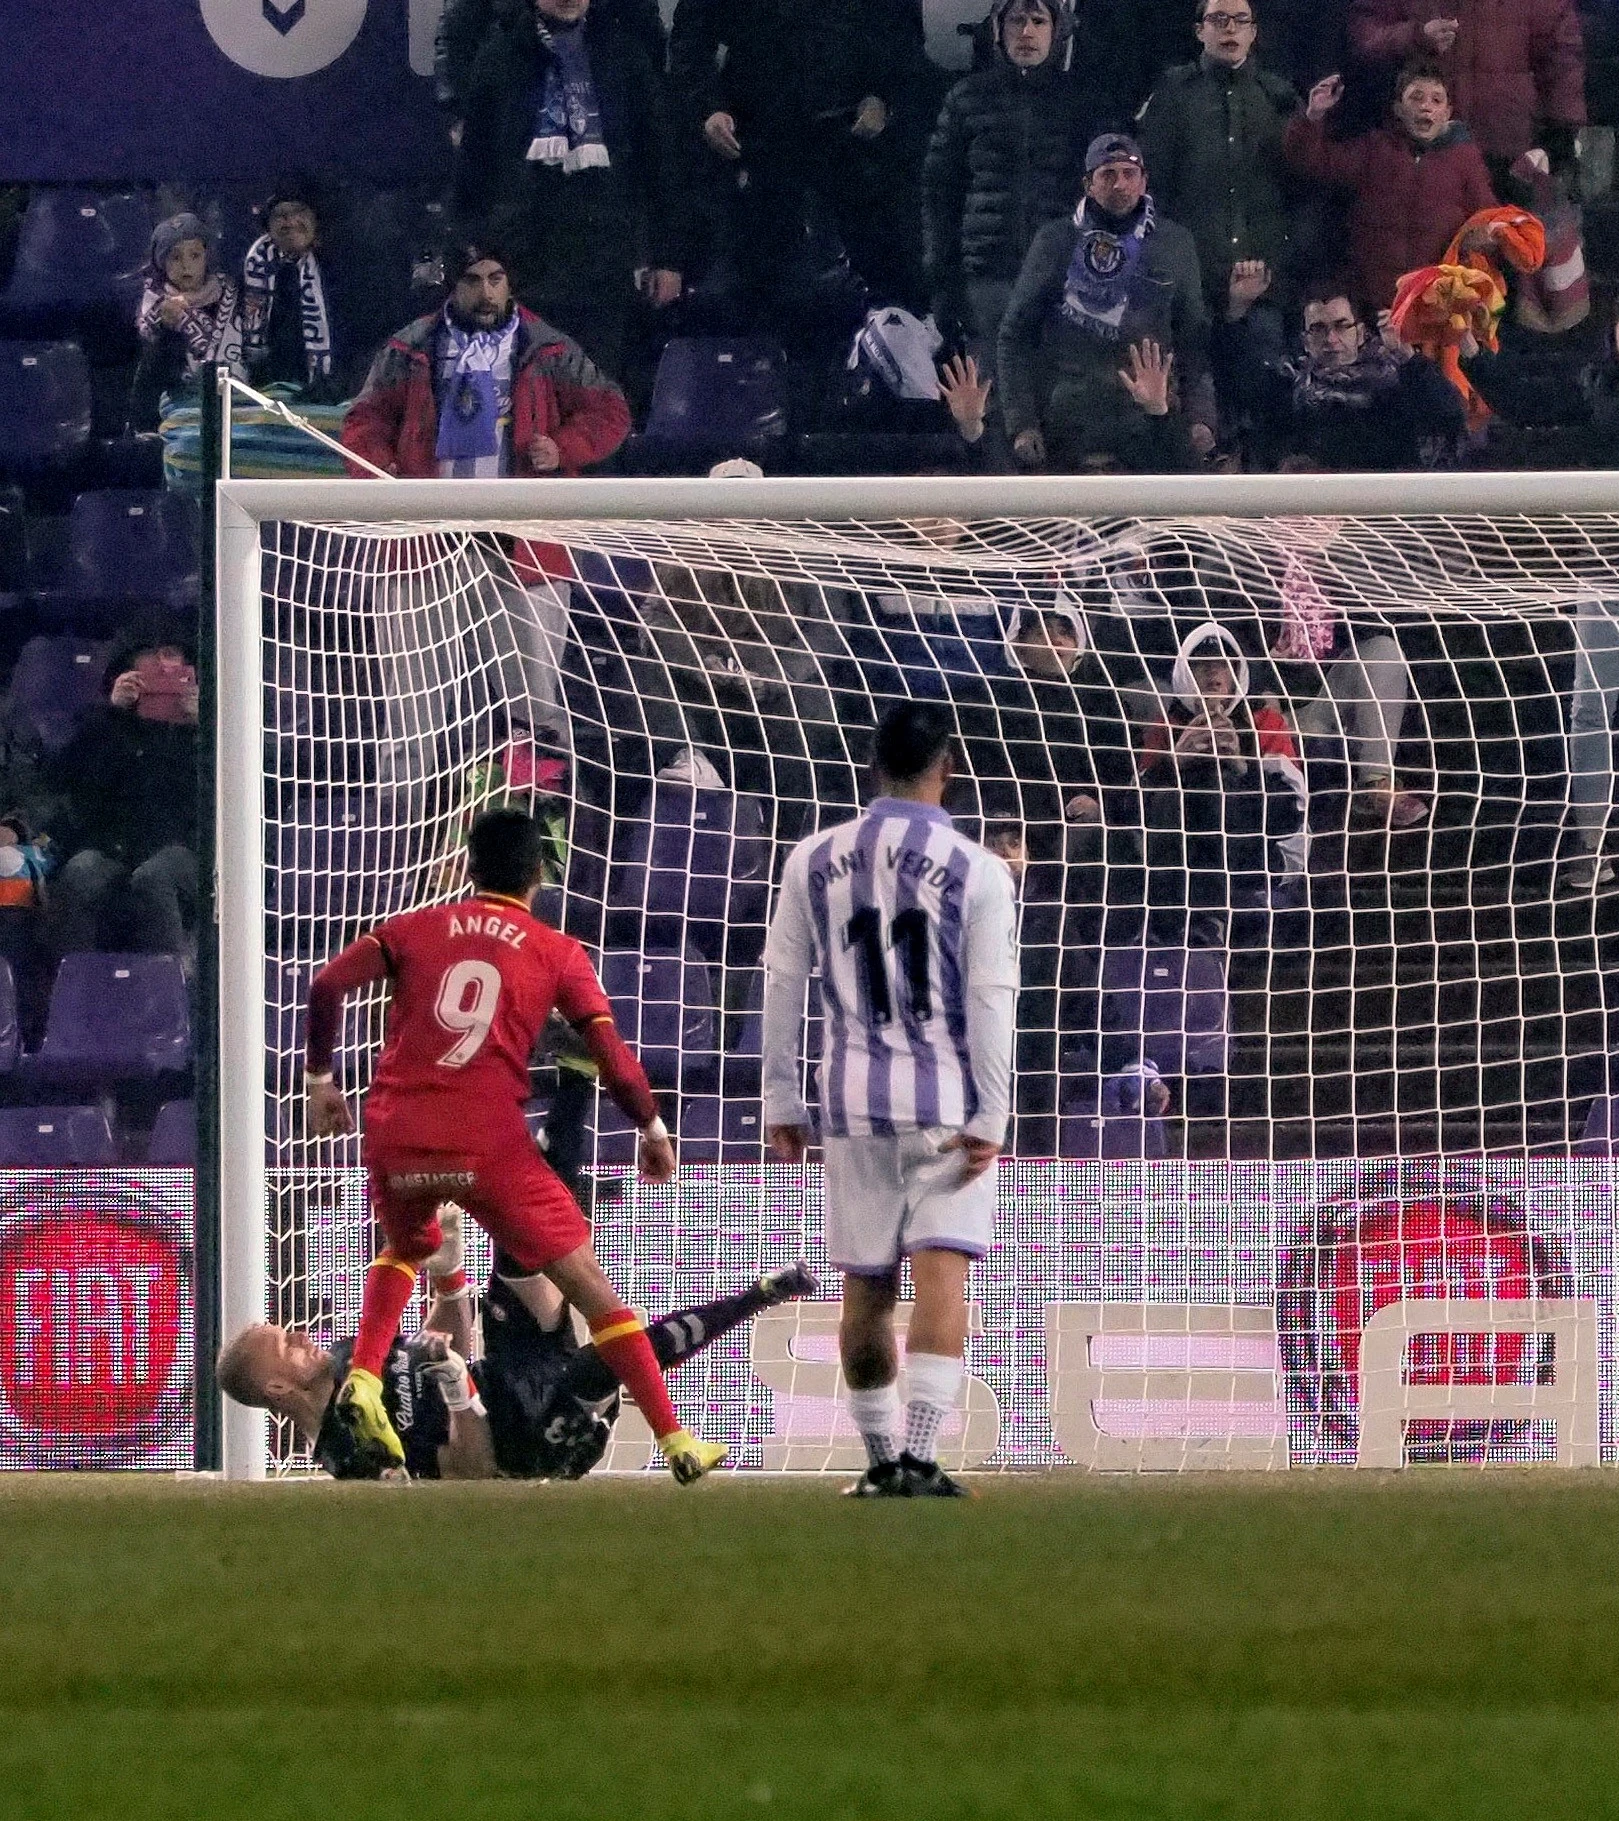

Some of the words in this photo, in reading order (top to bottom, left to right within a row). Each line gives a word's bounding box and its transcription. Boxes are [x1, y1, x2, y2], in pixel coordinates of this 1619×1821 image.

[433, 959, 502, 1069] 9
[841, 905, 934, 1027] 11
[14, 1265, 163, 1387] FIAT
